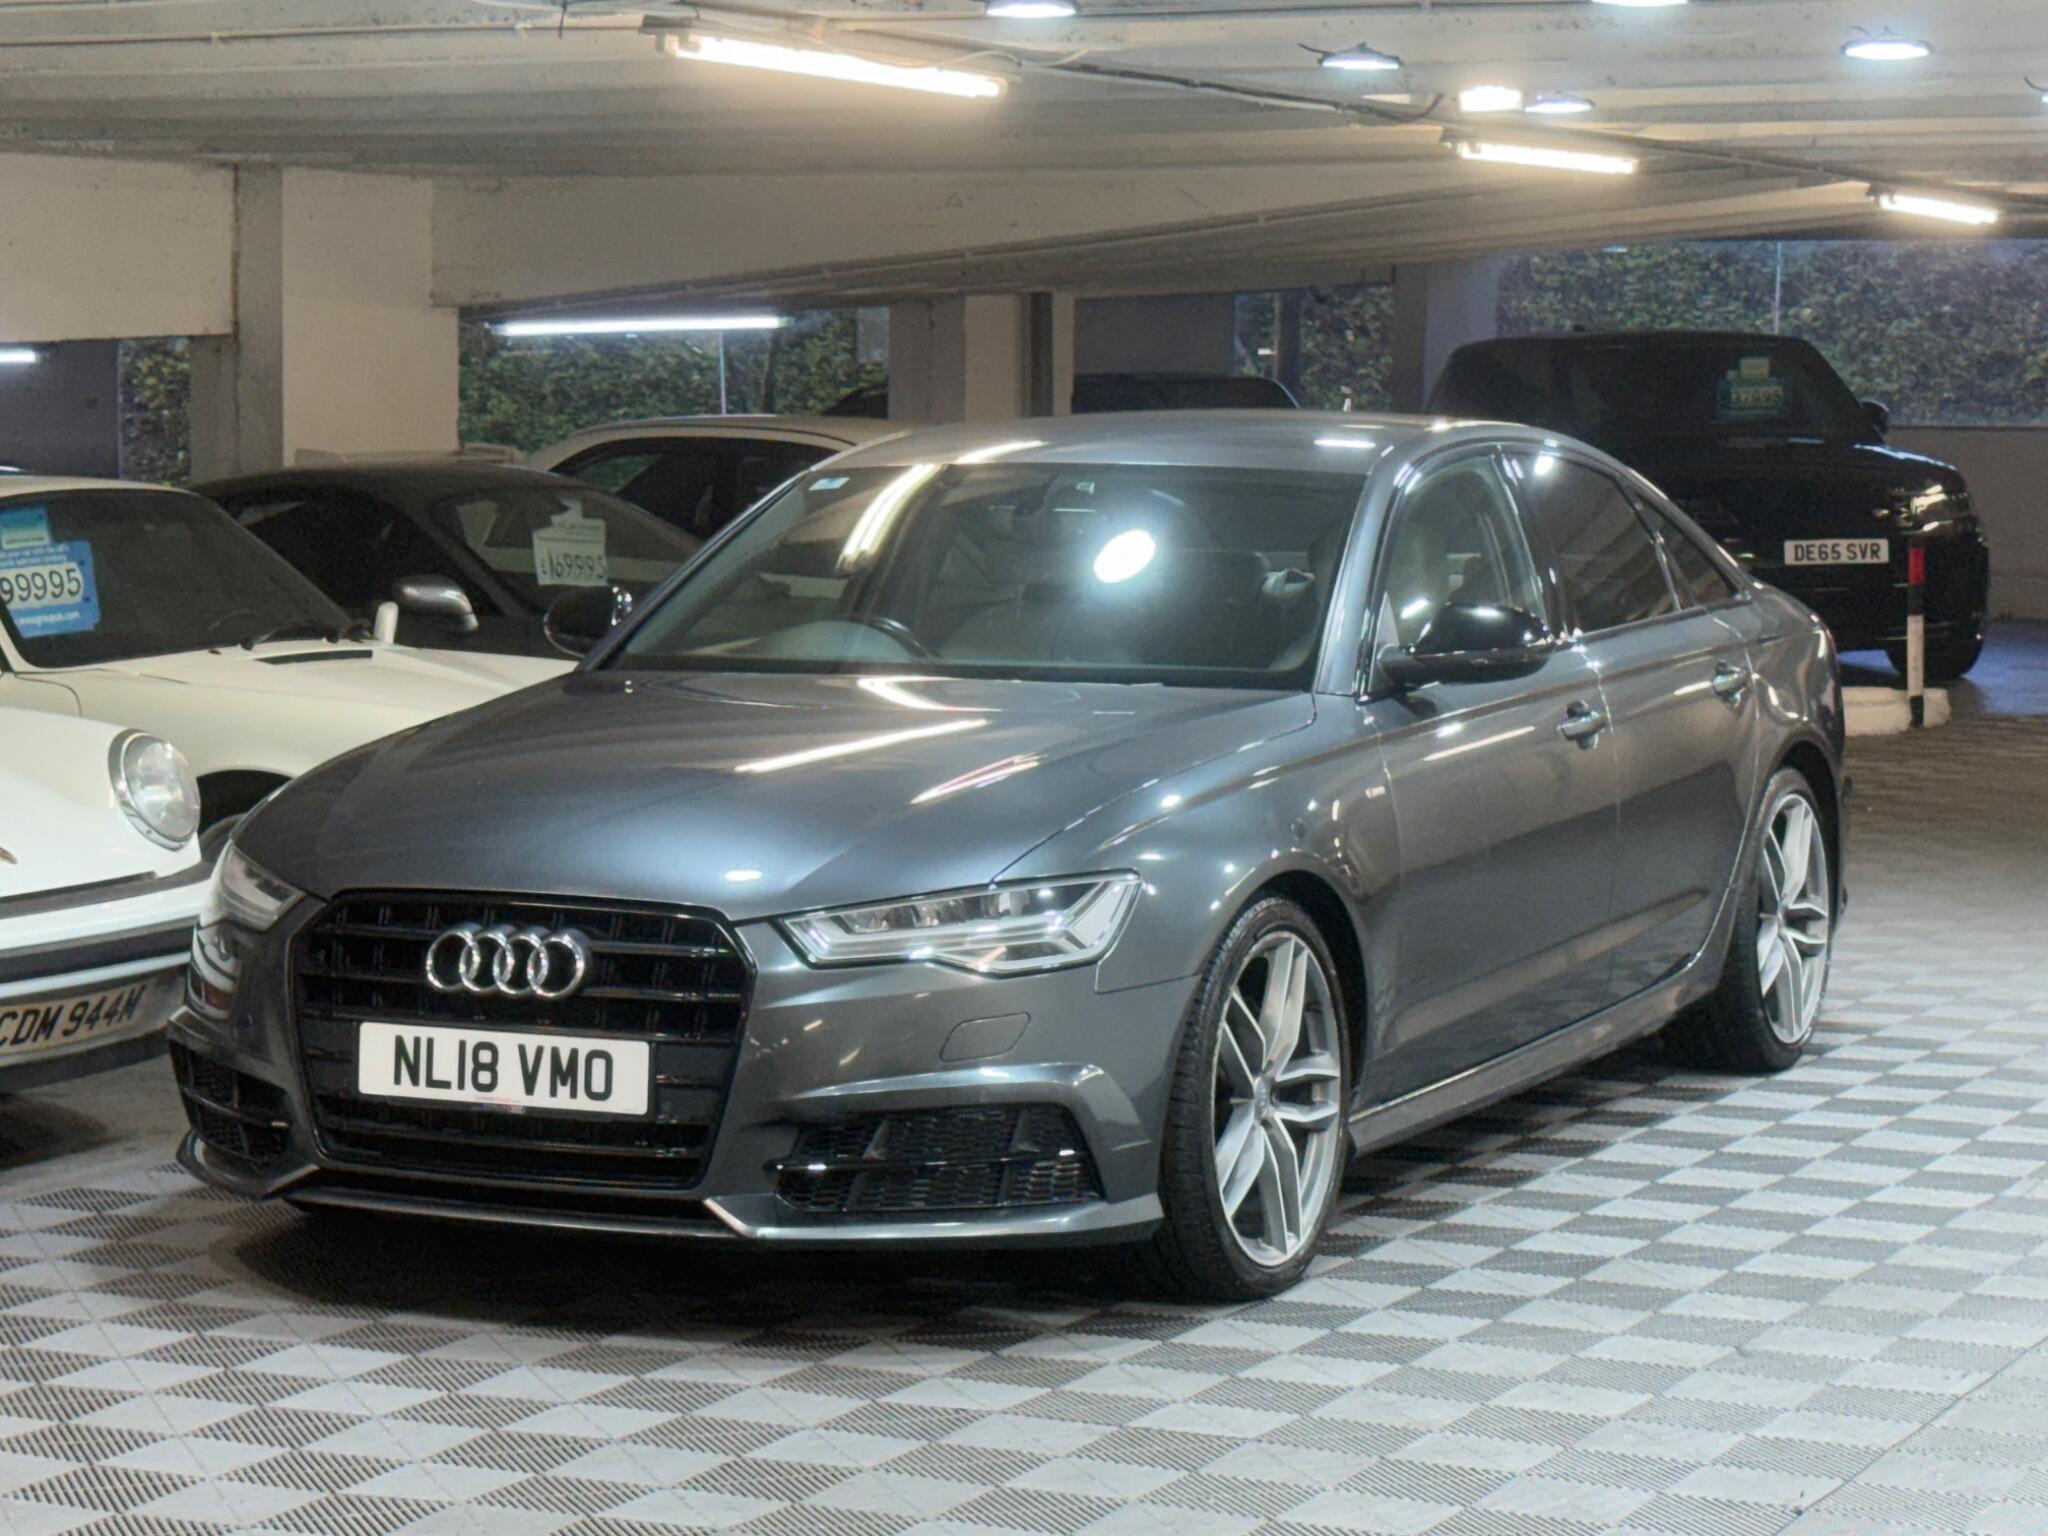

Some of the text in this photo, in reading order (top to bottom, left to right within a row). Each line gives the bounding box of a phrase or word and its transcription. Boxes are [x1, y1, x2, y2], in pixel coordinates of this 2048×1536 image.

[1793, 542, 1881, 561] DE65 SVR
[0, 567, 82, 605] 99995
[0, 1004, 64, 1047] CDM
[393, 1034, 614, 1102] NL18 VMO
